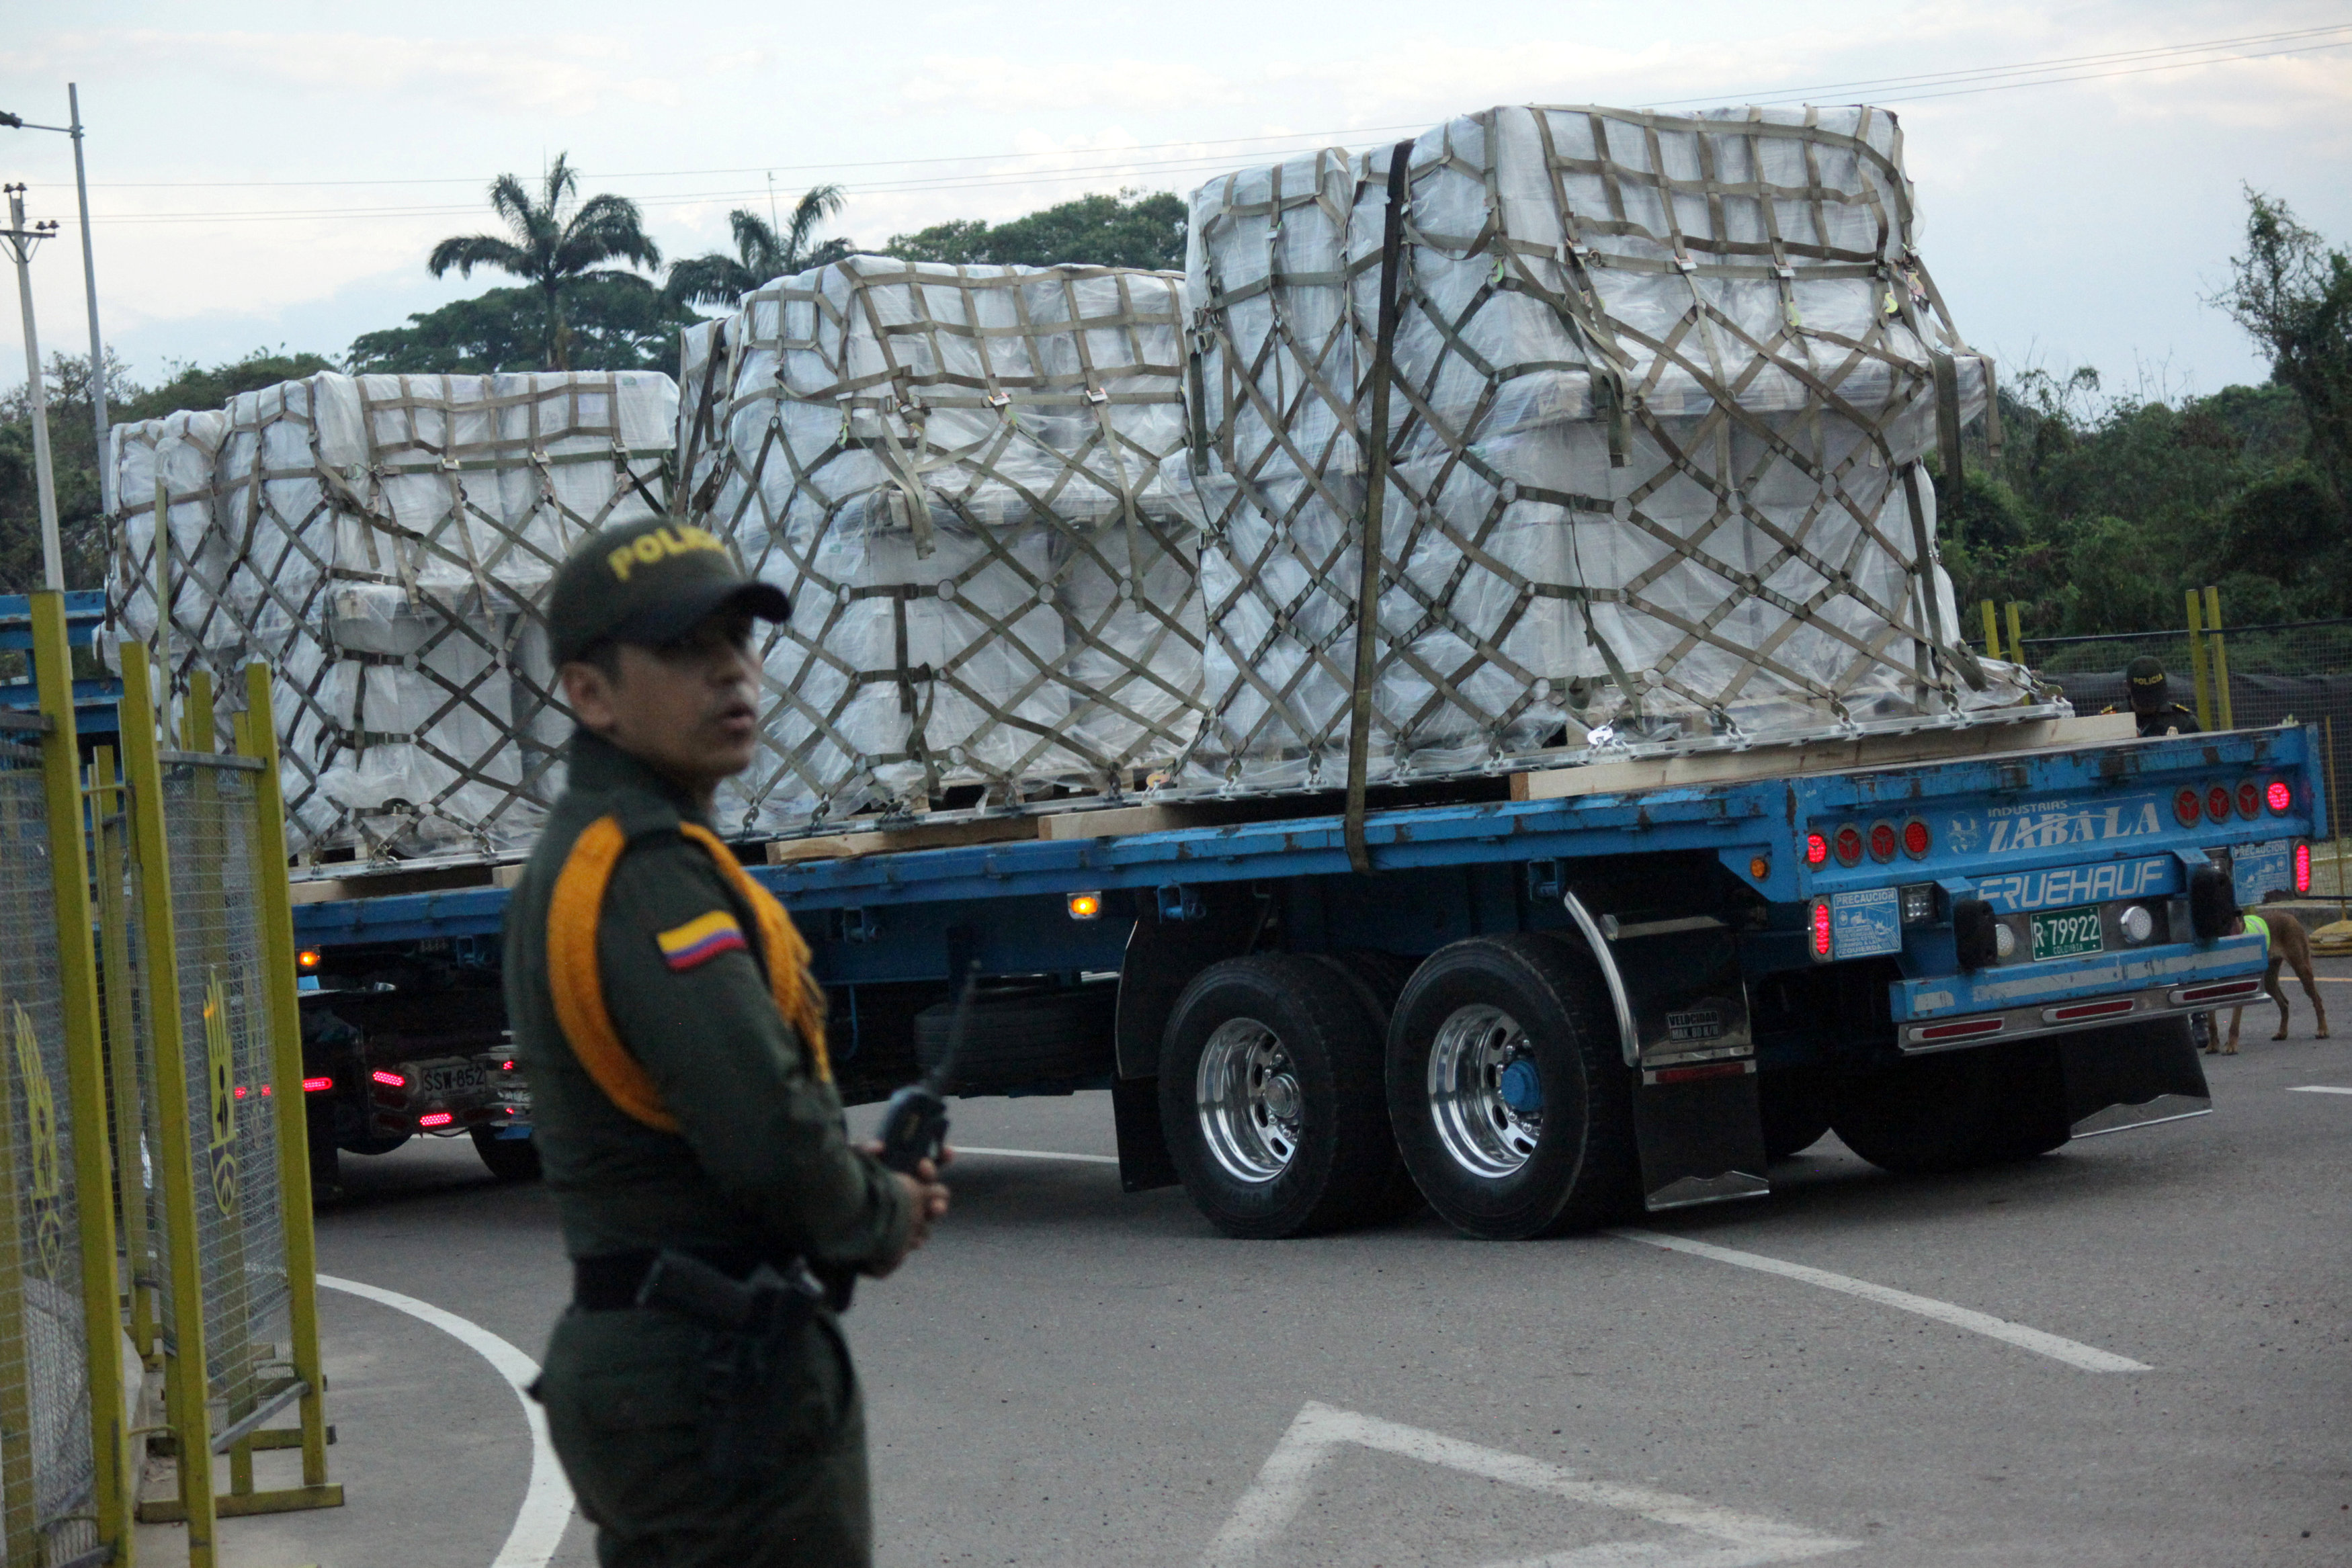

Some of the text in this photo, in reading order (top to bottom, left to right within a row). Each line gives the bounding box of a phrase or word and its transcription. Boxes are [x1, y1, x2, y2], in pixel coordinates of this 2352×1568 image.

[2133, 672, 2162, 685] POLICIA
[1988, 800, 2068, 818] INDUSTRIAS
[1988, 803, 2162, 853] ZABALA
[2234, 842, 2286, 857] PRECAUCION
[1978, 859, 2165, 910] FRUEHAUF
[1836, 890, 1894, 906] PRECAUCION
[2053, 943, 2083, 955] COLOMBIA
